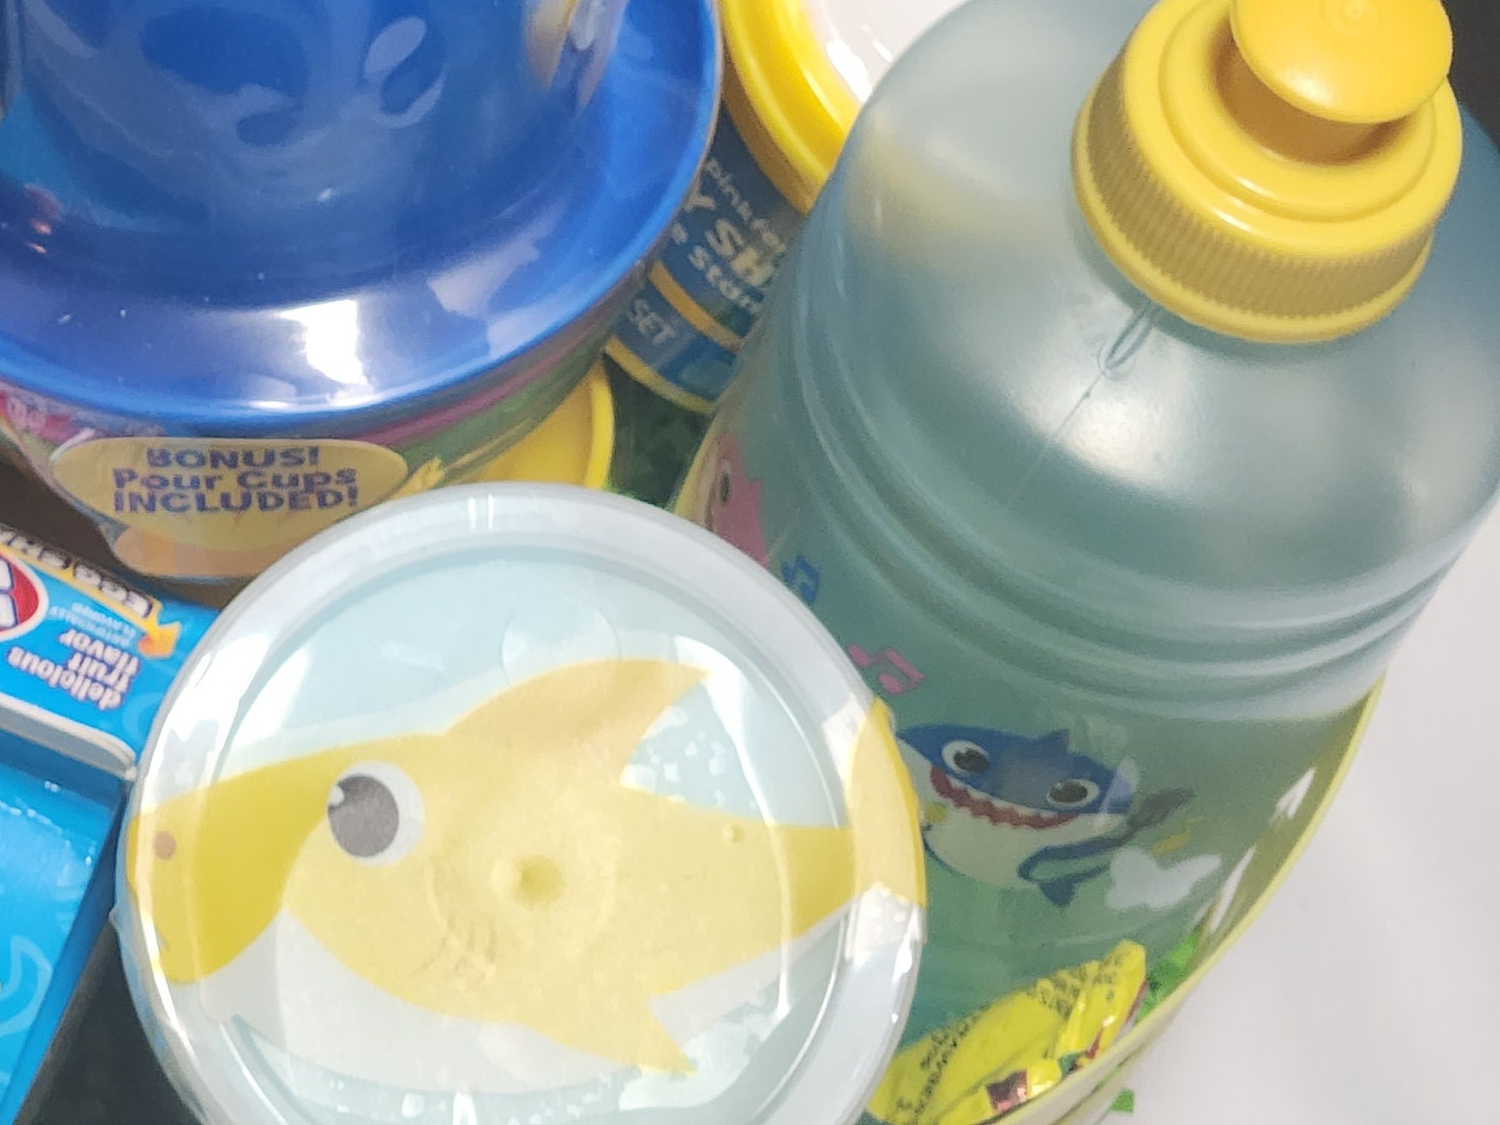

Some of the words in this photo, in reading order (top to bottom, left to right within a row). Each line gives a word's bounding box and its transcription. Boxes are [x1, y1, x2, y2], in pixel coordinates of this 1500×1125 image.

[146, 445, 320, 471] BONUS!
[113, 467, 228, 492] Pour
[236, 466, 359, 493] Cups
[113, 483, 360, 514] INCLUDED!
[57, 627, 141, 676] flavor
[67, 651, 131, 694] fruit
